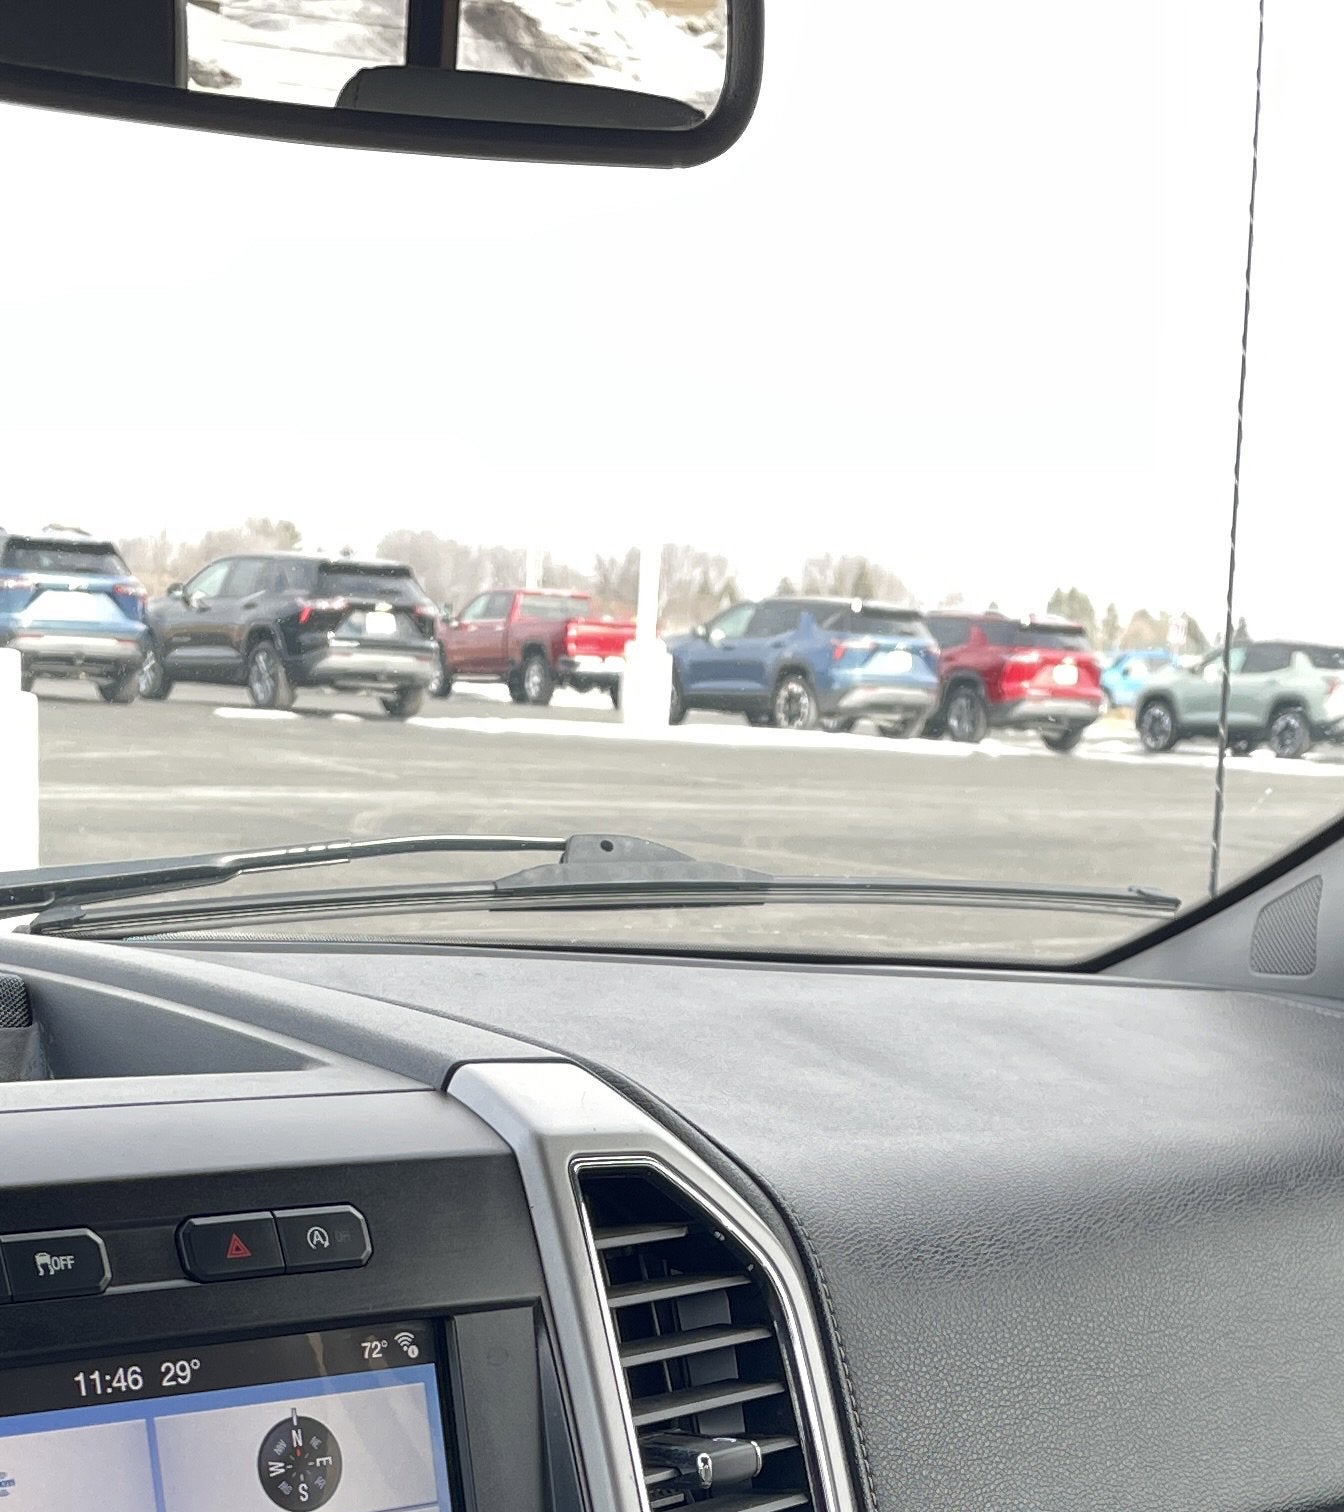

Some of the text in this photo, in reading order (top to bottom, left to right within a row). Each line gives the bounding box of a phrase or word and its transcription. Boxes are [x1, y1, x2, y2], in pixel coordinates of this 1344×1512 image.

[52, 1256, 75, 1270] OFF
[361, 1340, 387, 1359] 72°
[74, 1359, 201, 1396] 11:46 29°
[291, 1428, 302, 1447] N
[298, 1483, 309, 1502] S
